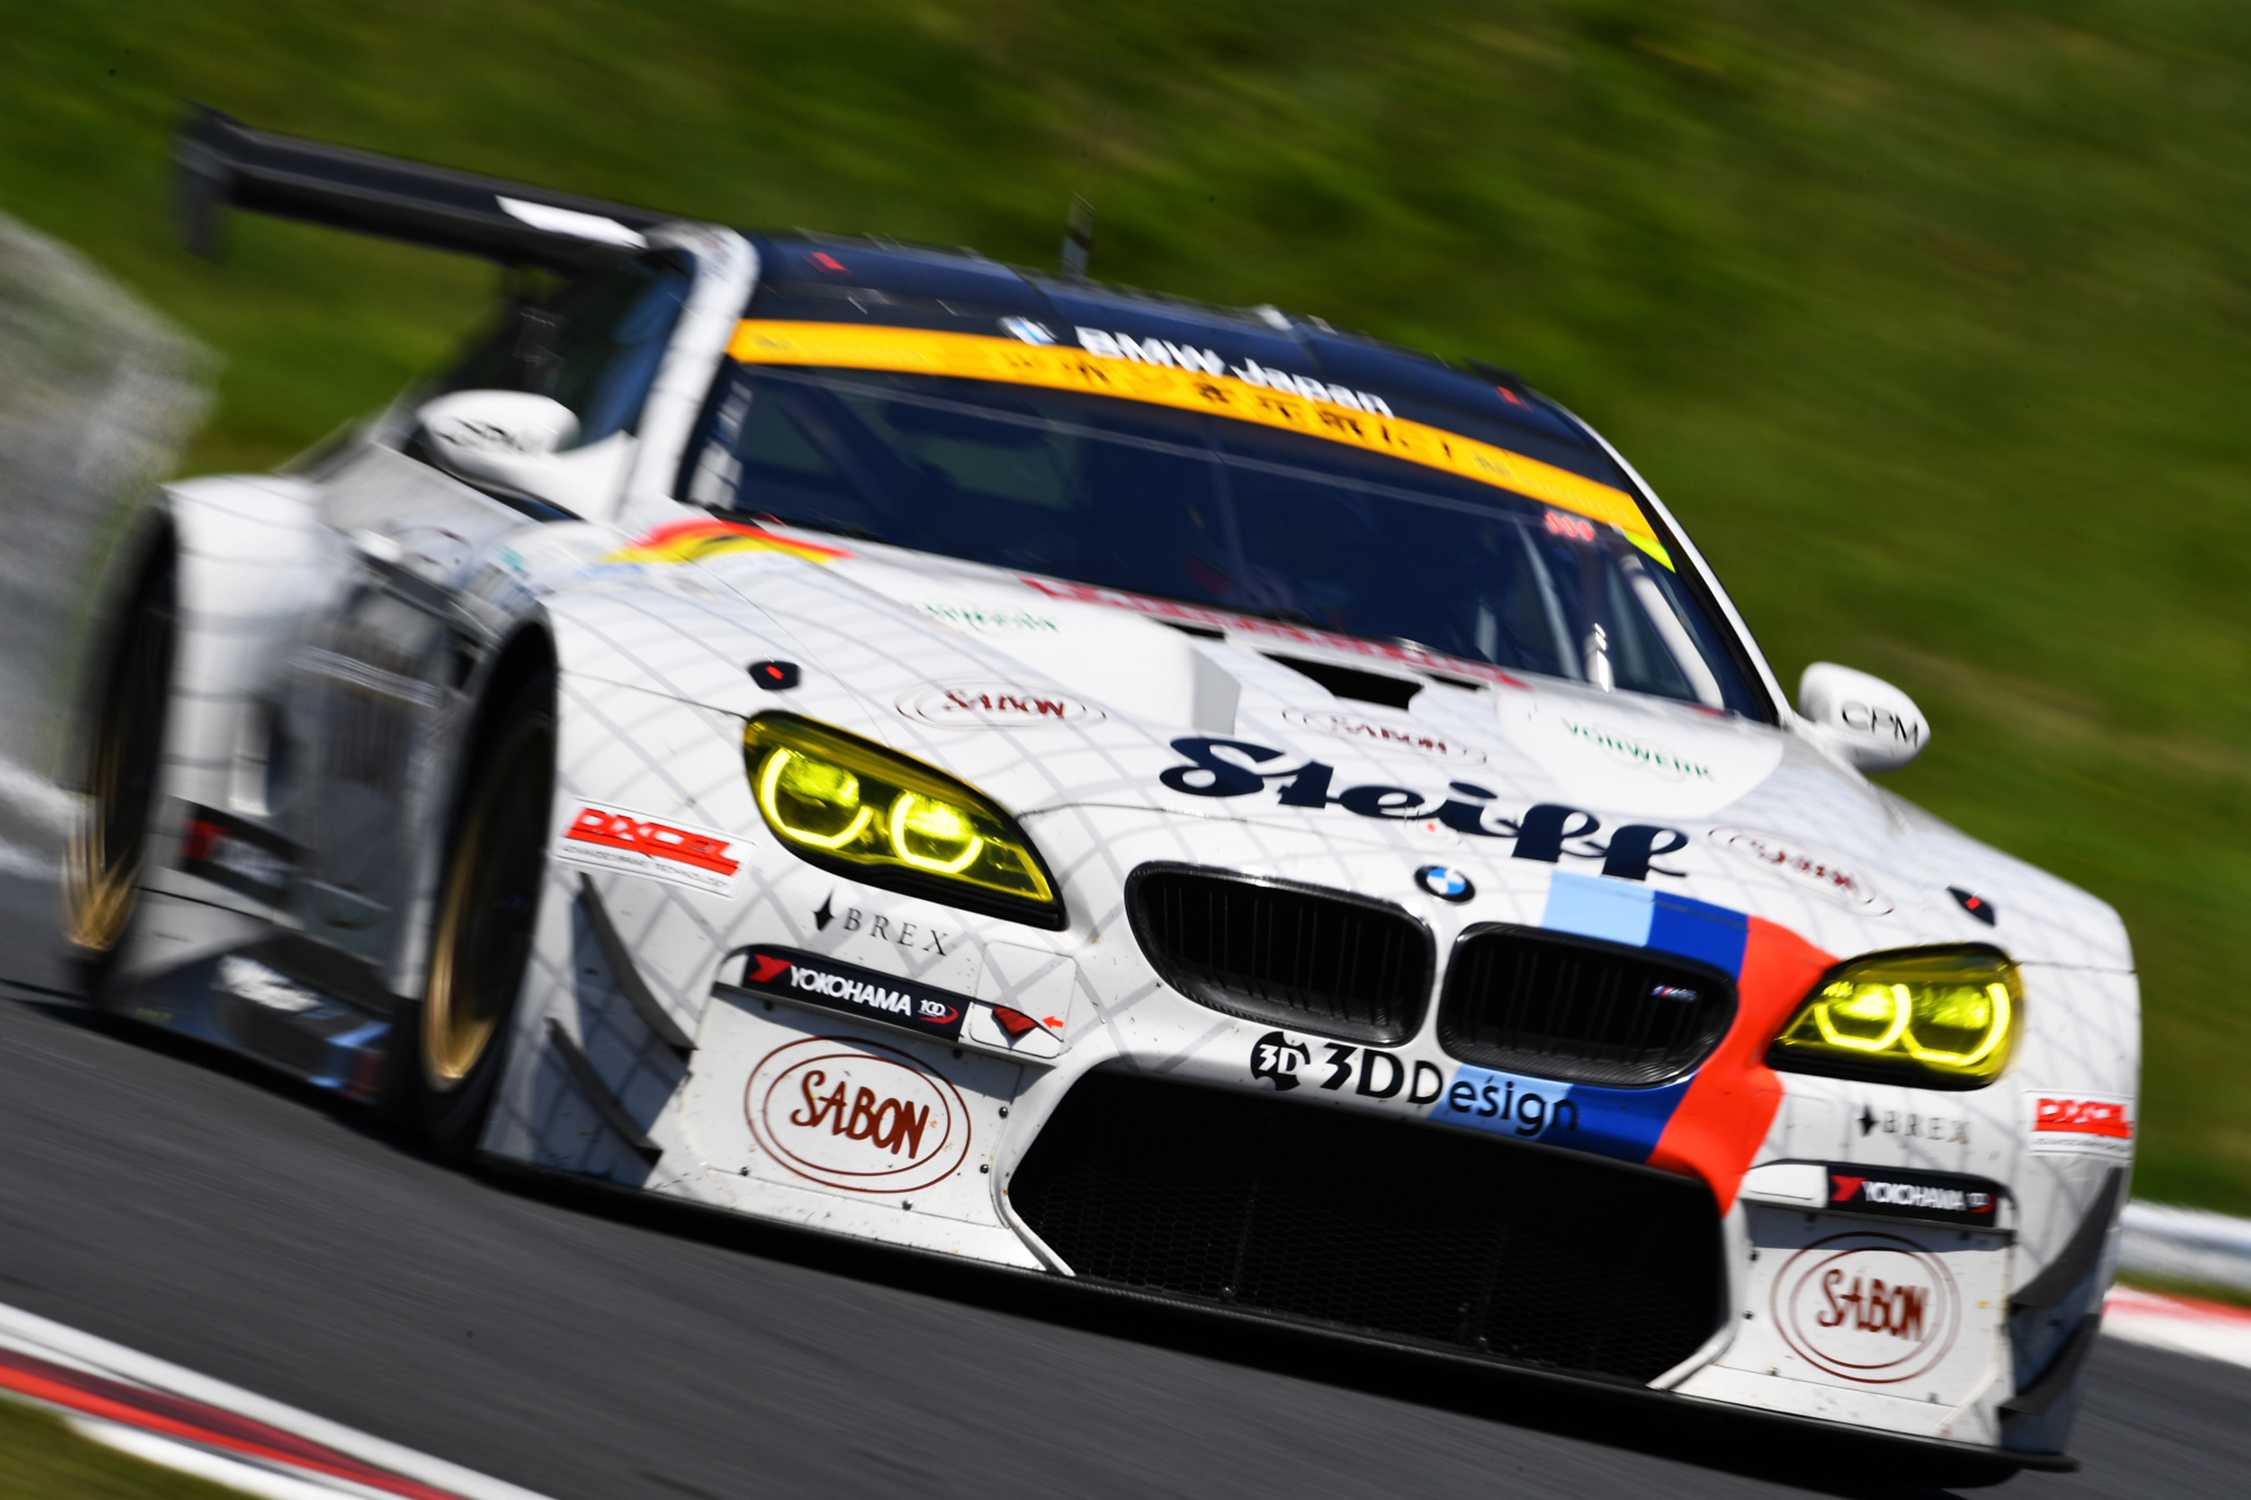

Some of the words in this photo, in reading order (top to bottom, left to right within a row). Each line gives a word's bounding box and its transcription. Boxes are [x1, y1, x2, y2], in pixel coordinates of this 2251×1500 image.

[1074, 325, 1226, 377] BMW
[1229, 357, 1396, 419] Japan
[1840, 701, 1919, 750] CPM
[1159, 736, 1690, 882] Steiff
[842, 907, 949, 957] BREX
[790, 964, 913, 1017] YOKOHAMA
[790, 1070, 930, 1160] SABON
[1882, 1110, 1970, 1145] BREX
[1861, 1181, 1967, 1212] YOKOHAMA
[1817, 1268, 1928, 1342] SABON
